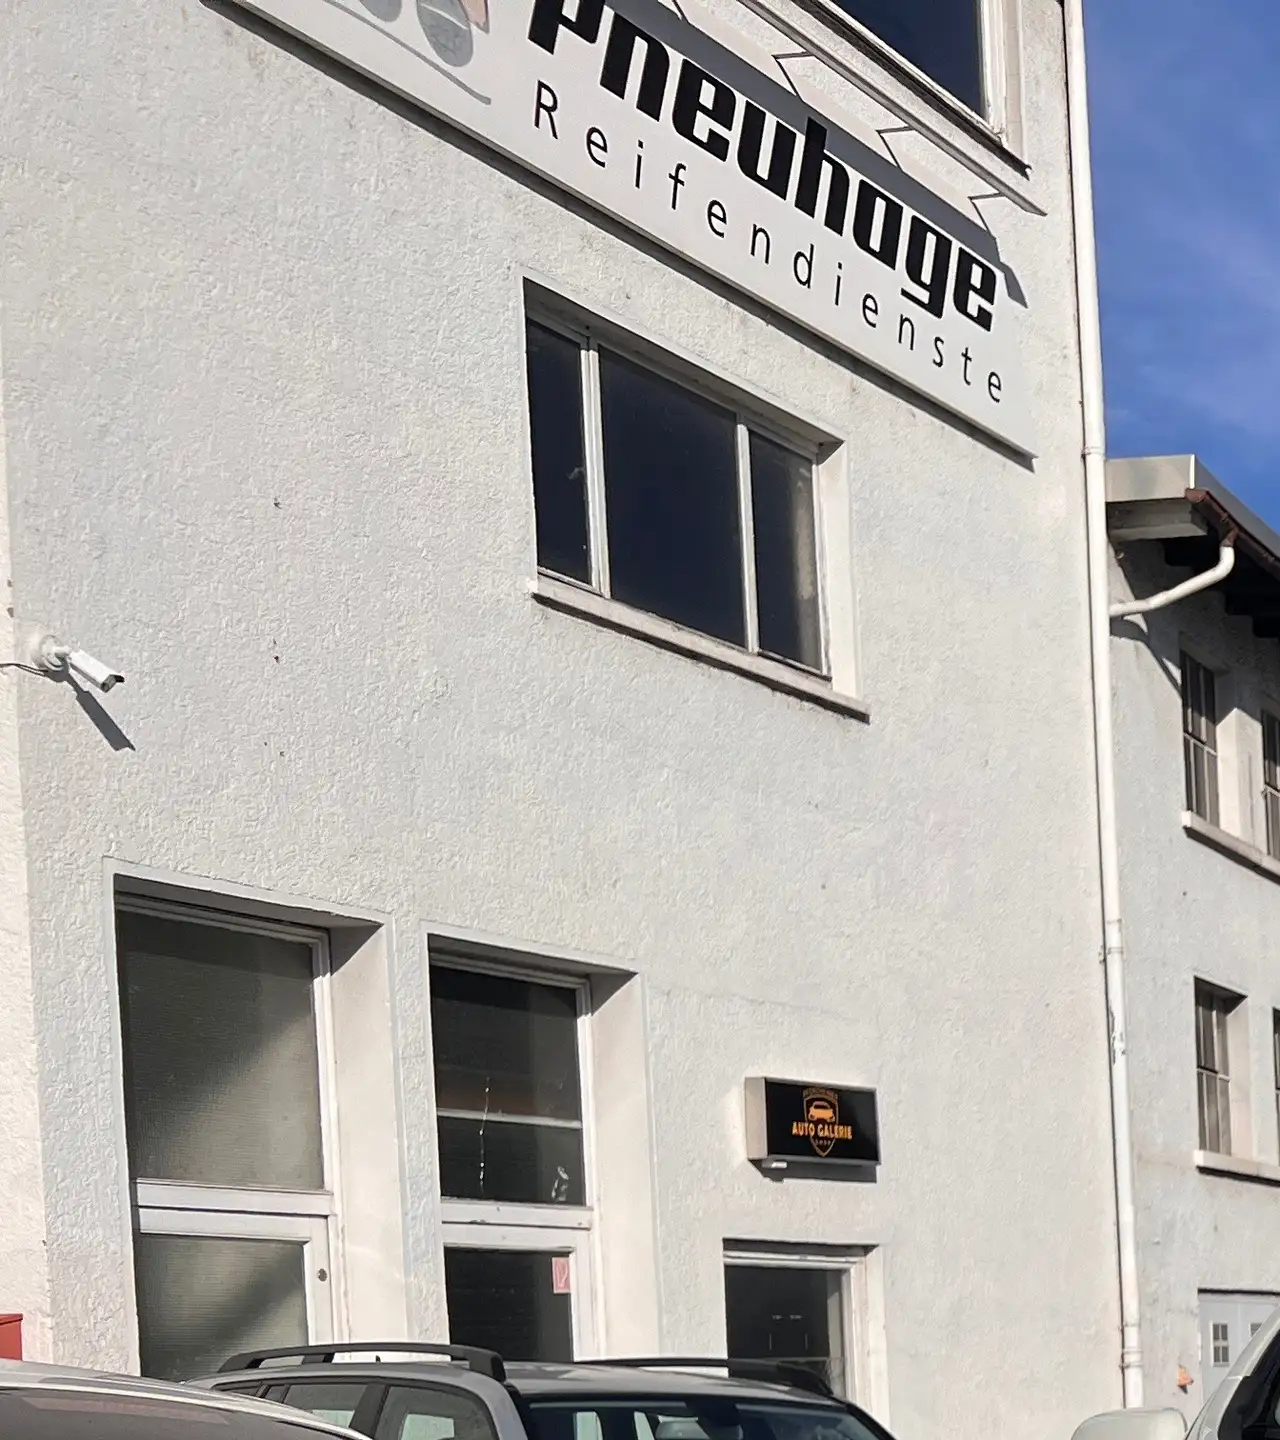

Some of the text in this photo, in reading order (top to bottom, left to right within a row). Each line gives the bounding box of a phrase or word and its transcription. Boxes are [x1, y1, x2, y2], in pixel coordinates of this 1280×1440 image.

[534, 80, 1001, 403] Reifendienste
[792, 1121, 852, 1140] AUTO GALERIE
